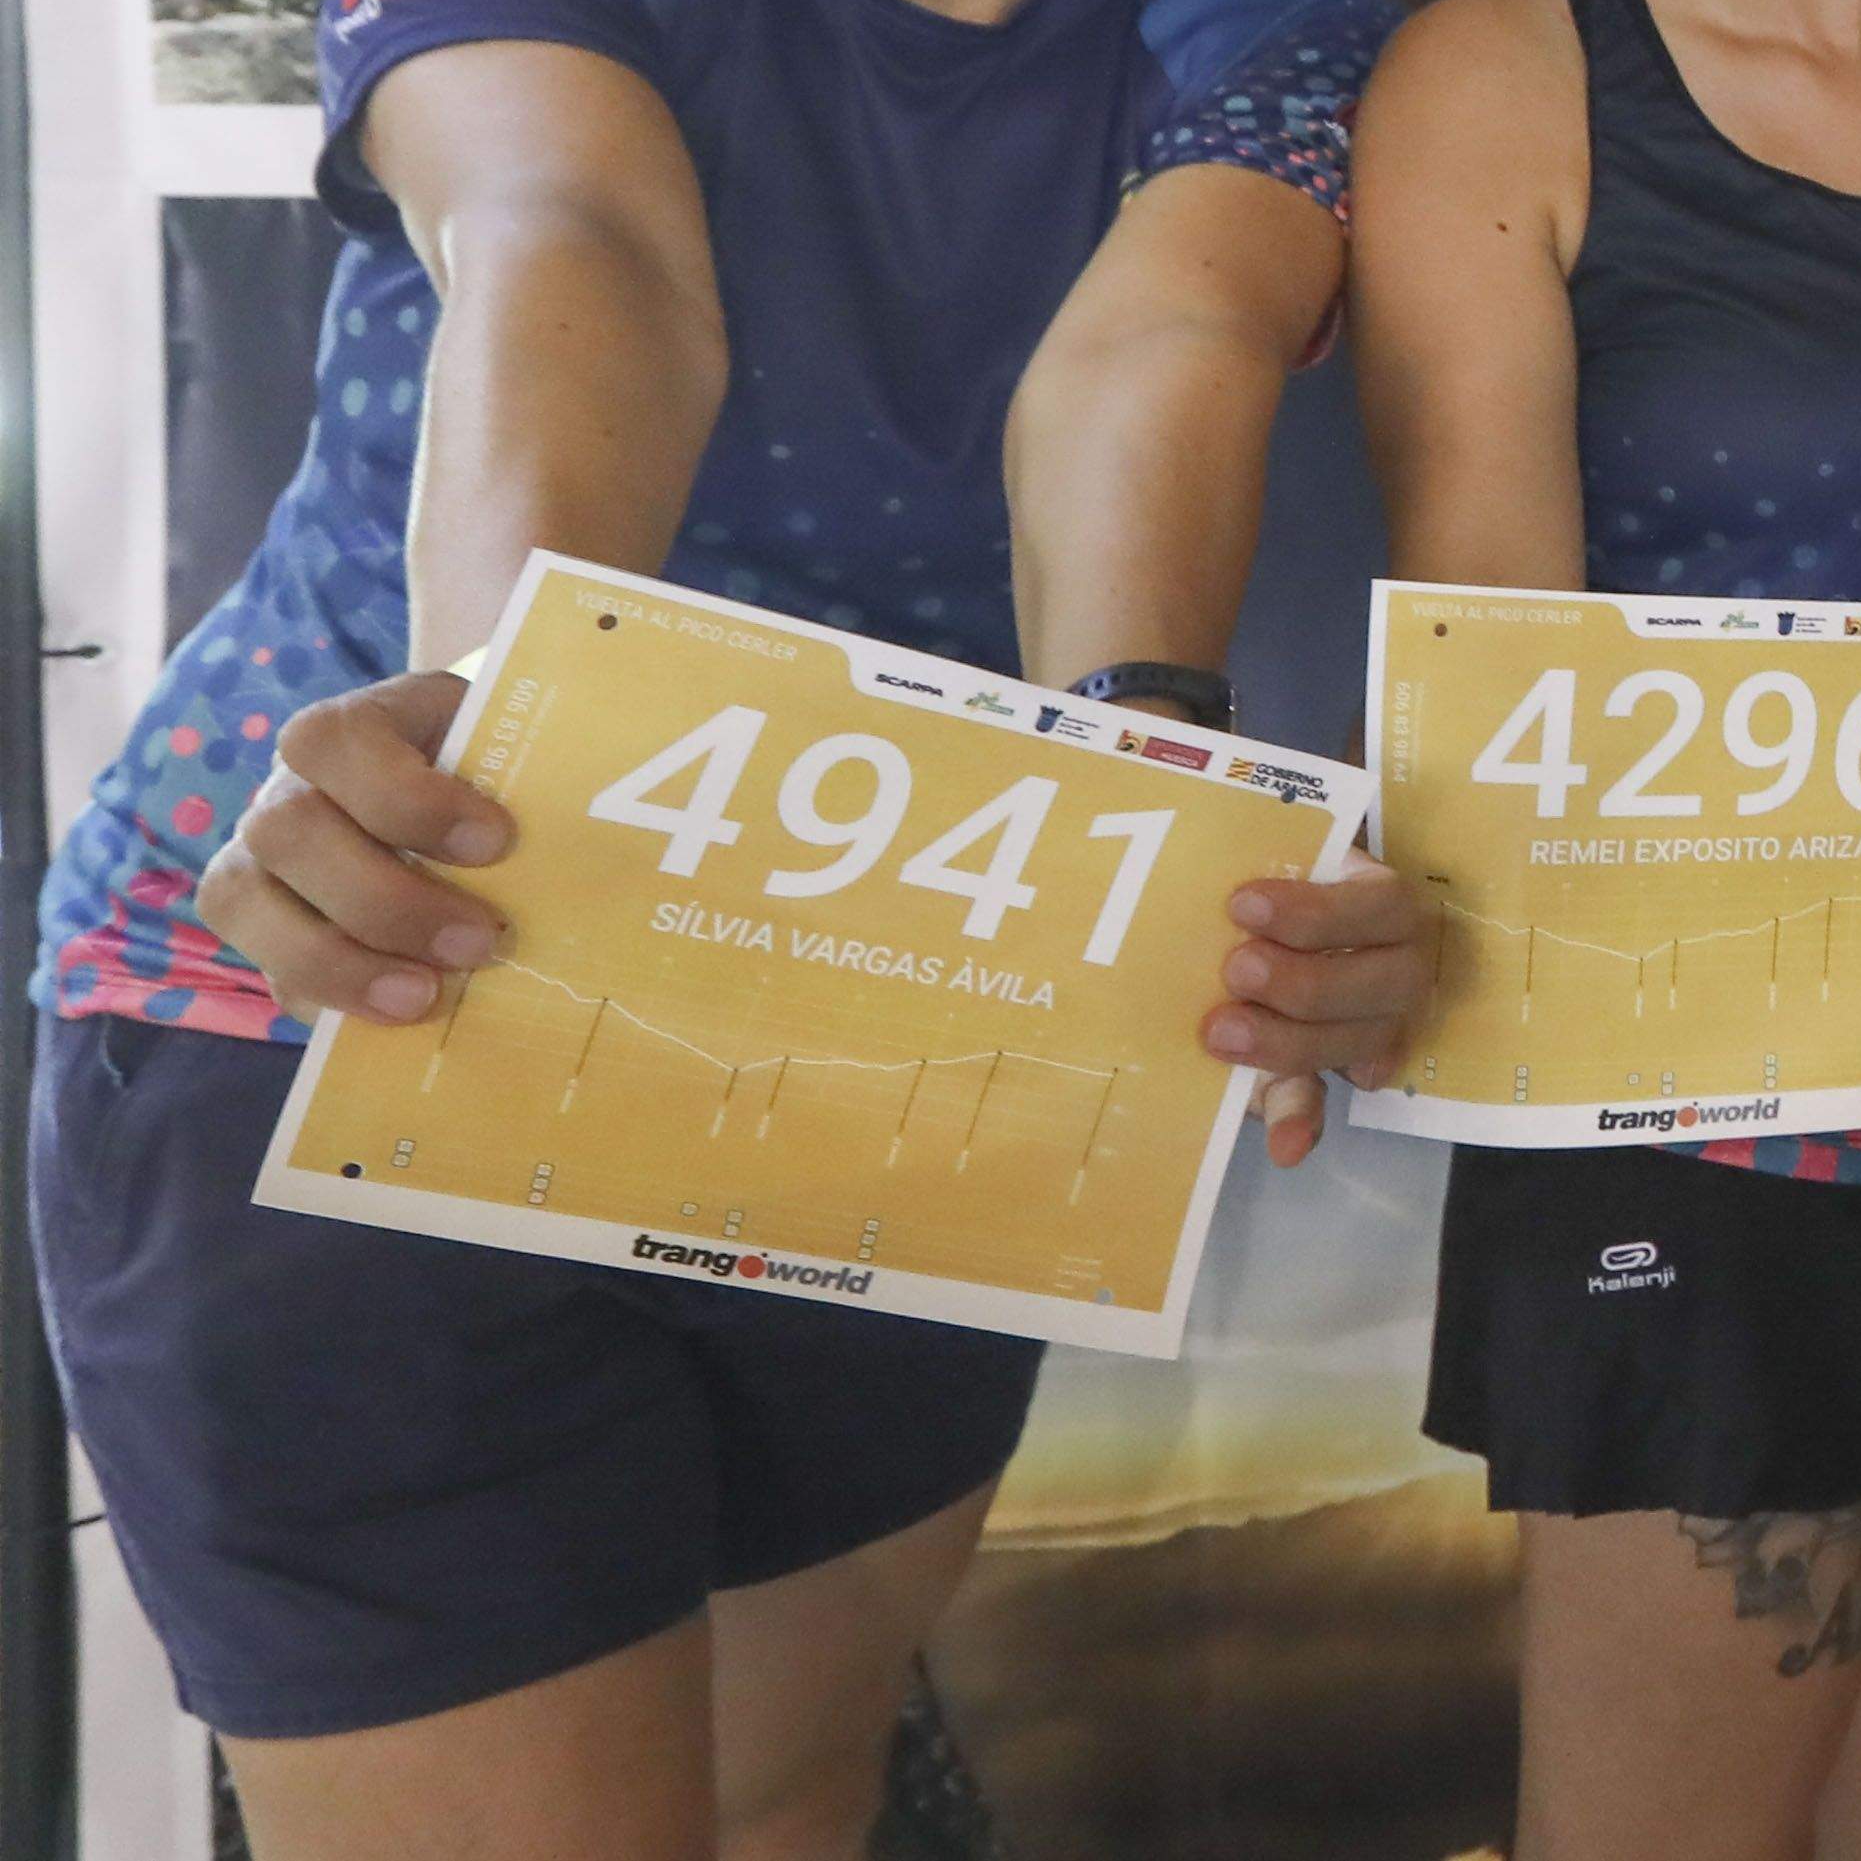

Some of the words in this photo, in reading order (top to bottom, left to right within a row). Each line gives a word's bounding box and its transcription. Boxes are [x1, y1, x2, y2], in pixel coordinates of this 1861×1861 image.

[576, 590, 645, 620] VUELTA
[649, 612, 671, 629] AL
[677, 616, 724, 643] PICO
[727, 632, 798, 661] CERLER
[1411, 602, 1464, 619] VUELTA
[1466, 604, 1484, 620] AL
[1488, 605, 1524, 622] PICO
[1526, 607, 1584, 625] CERLER
[1646, 617, 1702, 627] SCARPA
[874, 672, 945, 698] SCARPA
[1250, 774, 1267, 788] DE
[1255, 762, 1324, 788] GOBIERNO
[586, 704, 1176, 967] 4941
[1530, 840, 1625, 866] REMEI
[1635, 837, 1780, 863] EXPOSITO
[650, 901, 774, 952] SÍLVIA
[789, 929, 945, 986] VARGAS
[948, 957, 1056, 1011] ÀVILA
[1598, 1098, 1780, 1132] trangoworld
[631, 1234, 875, 1295] trangoworld
